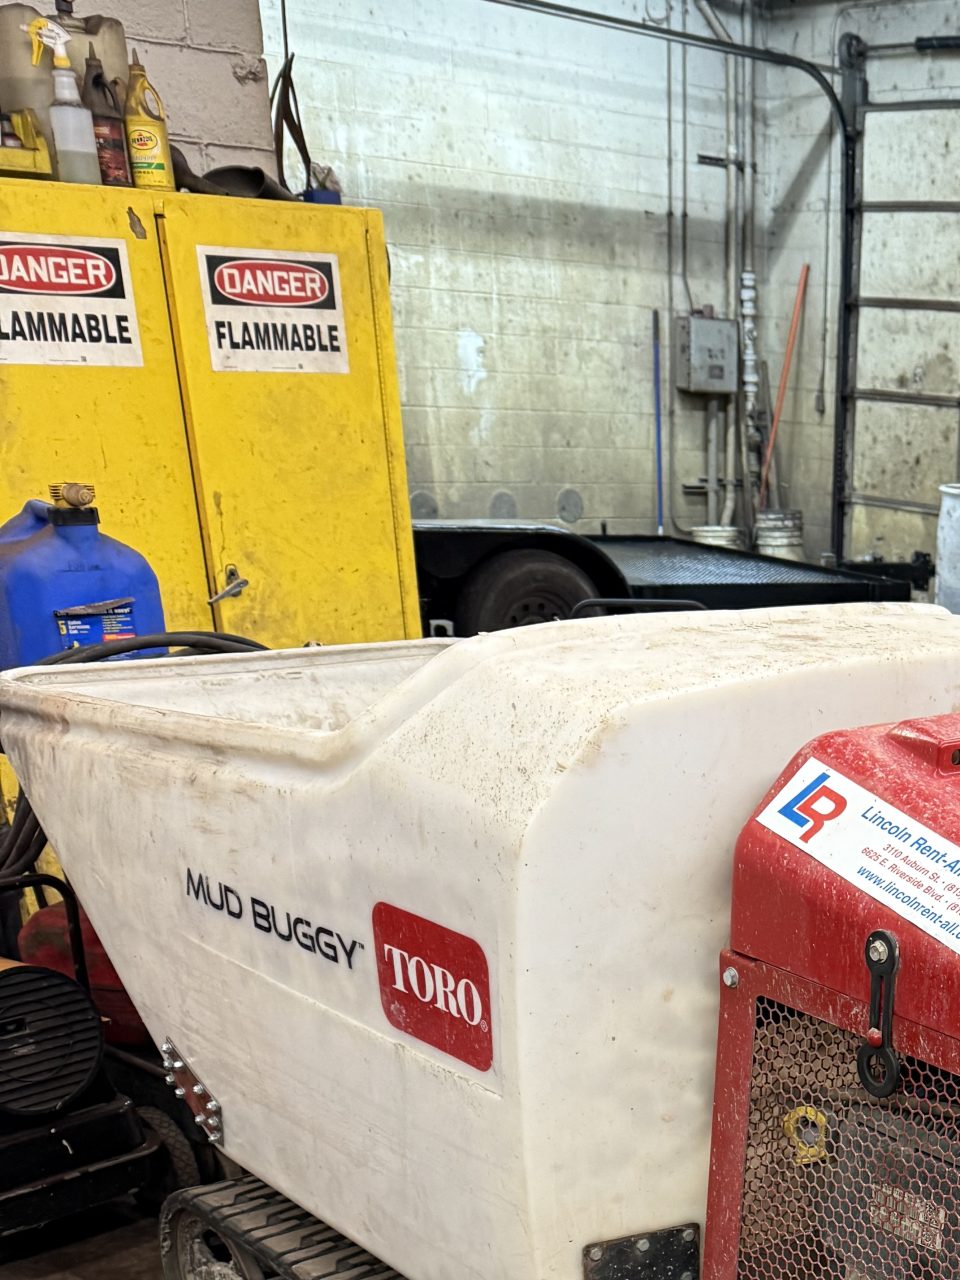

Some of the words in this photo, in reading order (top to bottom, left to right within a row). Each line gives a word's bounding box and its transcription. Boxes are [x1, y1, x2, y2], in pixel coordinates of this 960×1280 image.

[222, 267, 322, 297] DANGER
[214, 320, 341, 352] FLAMMABLE
[861, 806, 912, 843] Lincoln
[861, 846, 882, 862] 6625
[879, 857, 889, 868] E.
[887, 863, 924, 889] Riverside
[923, 884, 944, 903] Blvd.
[882, 844, 903, 859] 3110
[900, 855, 930, 876] Auburn
[929, 872, 941, 883] St.
[186, 867, 243, 919] MUD
